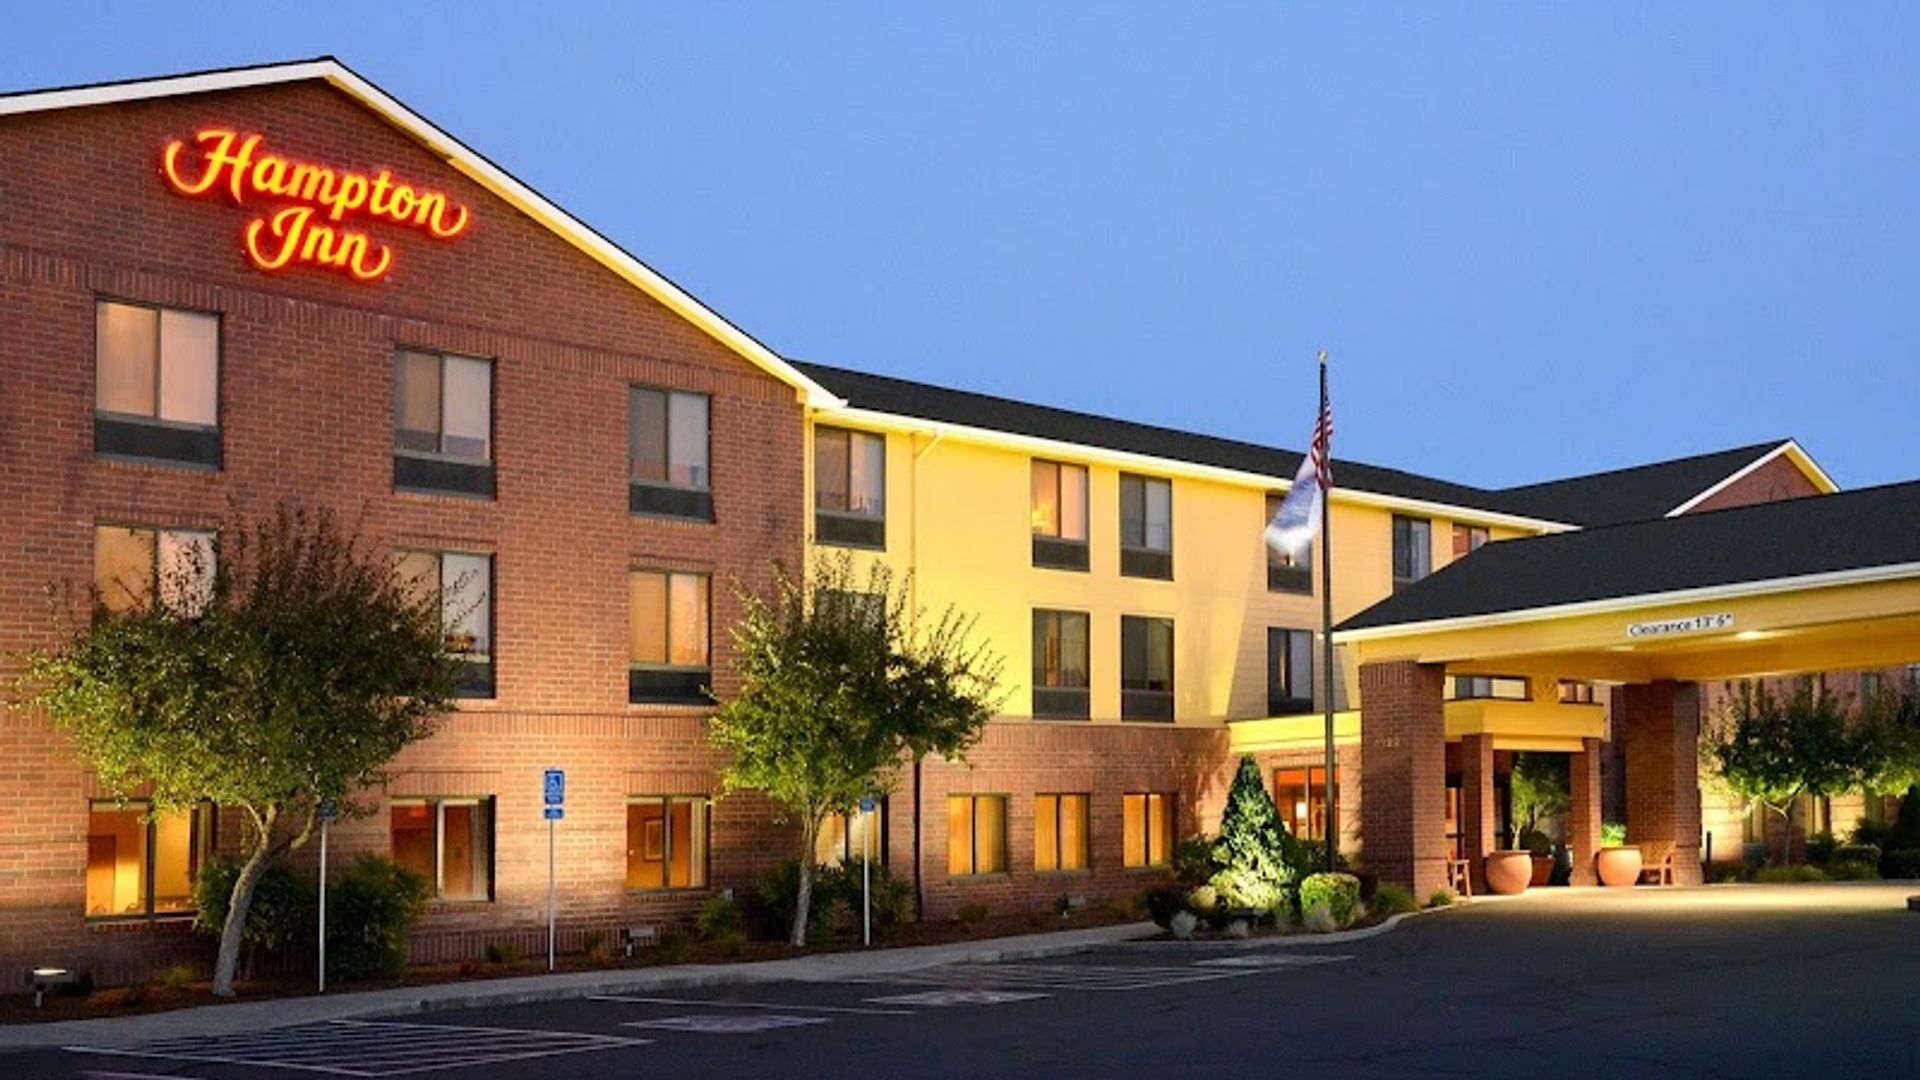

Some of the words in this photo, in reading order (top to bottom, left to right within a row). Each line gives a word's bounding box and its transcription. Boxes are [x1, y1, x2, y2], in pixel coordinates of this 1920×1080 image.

[164, 128, 468, 238] Hampton
[247, 206, 391, 280] Inn
[1629, 621, 1691, 637] Clearance
